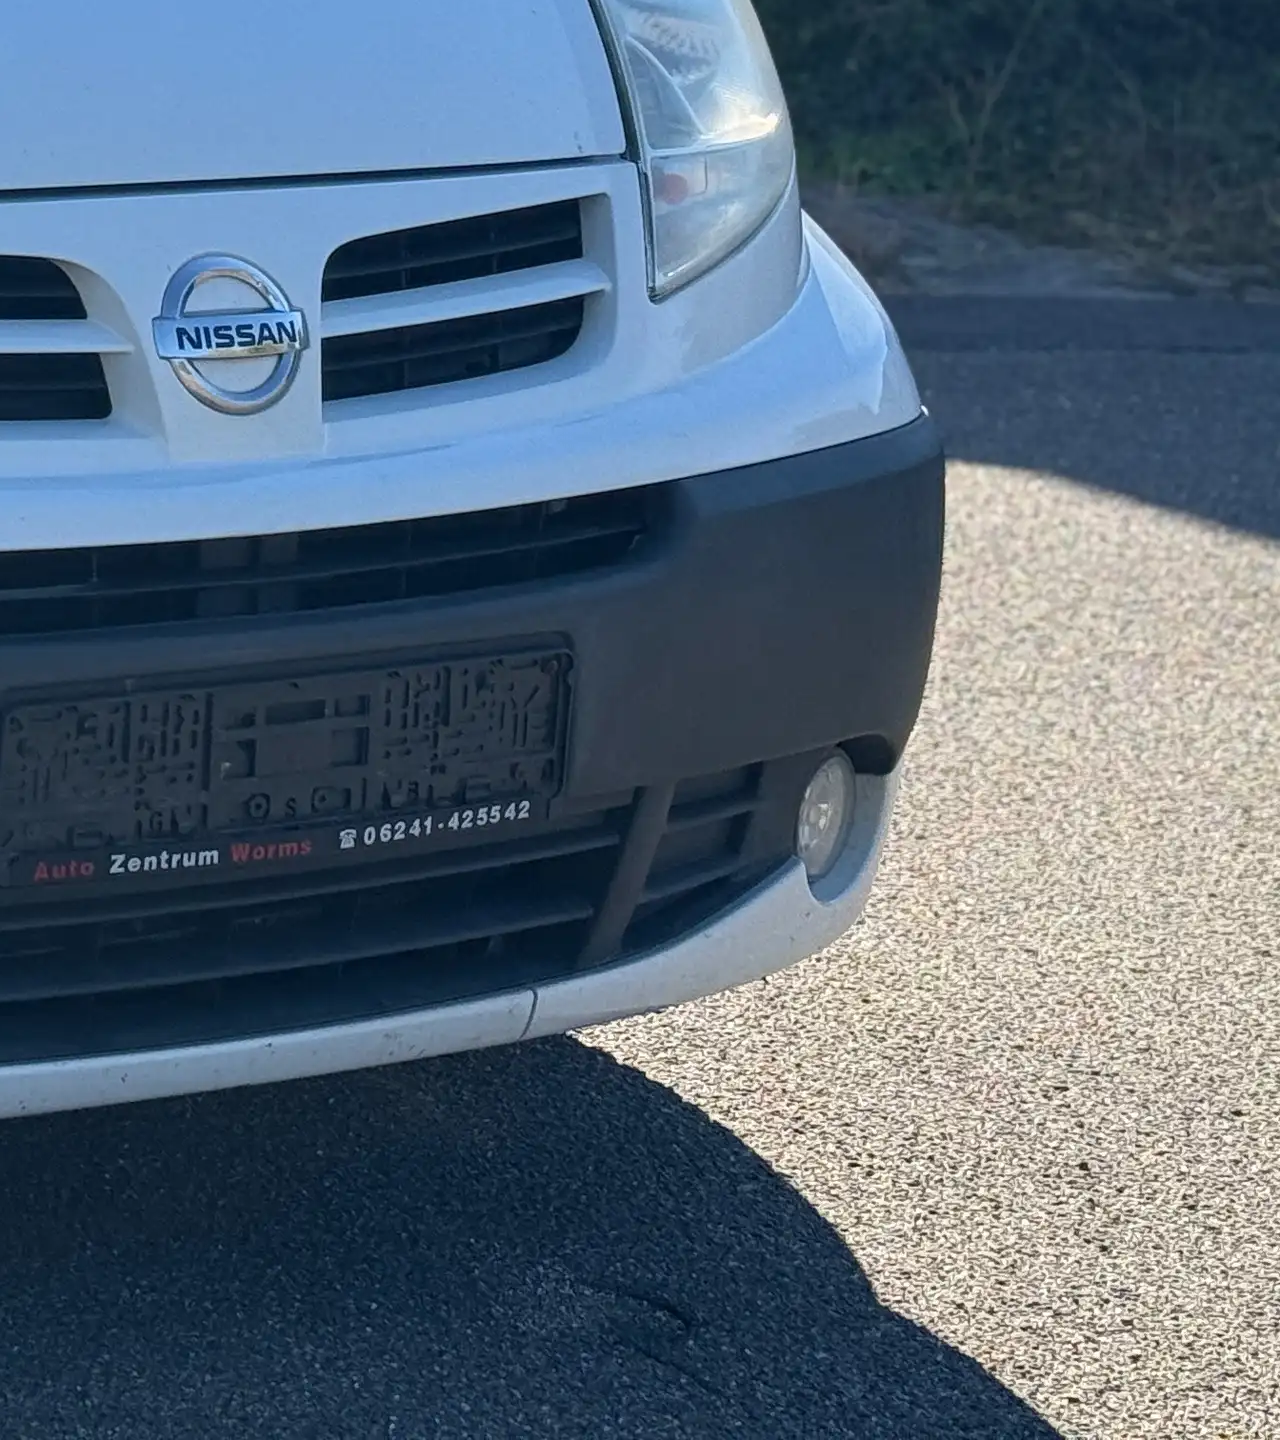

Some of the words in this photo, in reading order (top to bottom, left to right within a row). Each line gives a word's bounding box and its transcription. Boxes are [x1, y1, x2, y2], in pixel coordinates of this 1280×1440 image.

[175, 320, 297, 350] NISSAN
[33, 859, 95, 882] Auto
[109, 847, 220, 875] Zentrum
[230, 838, 313, 863] Worms
